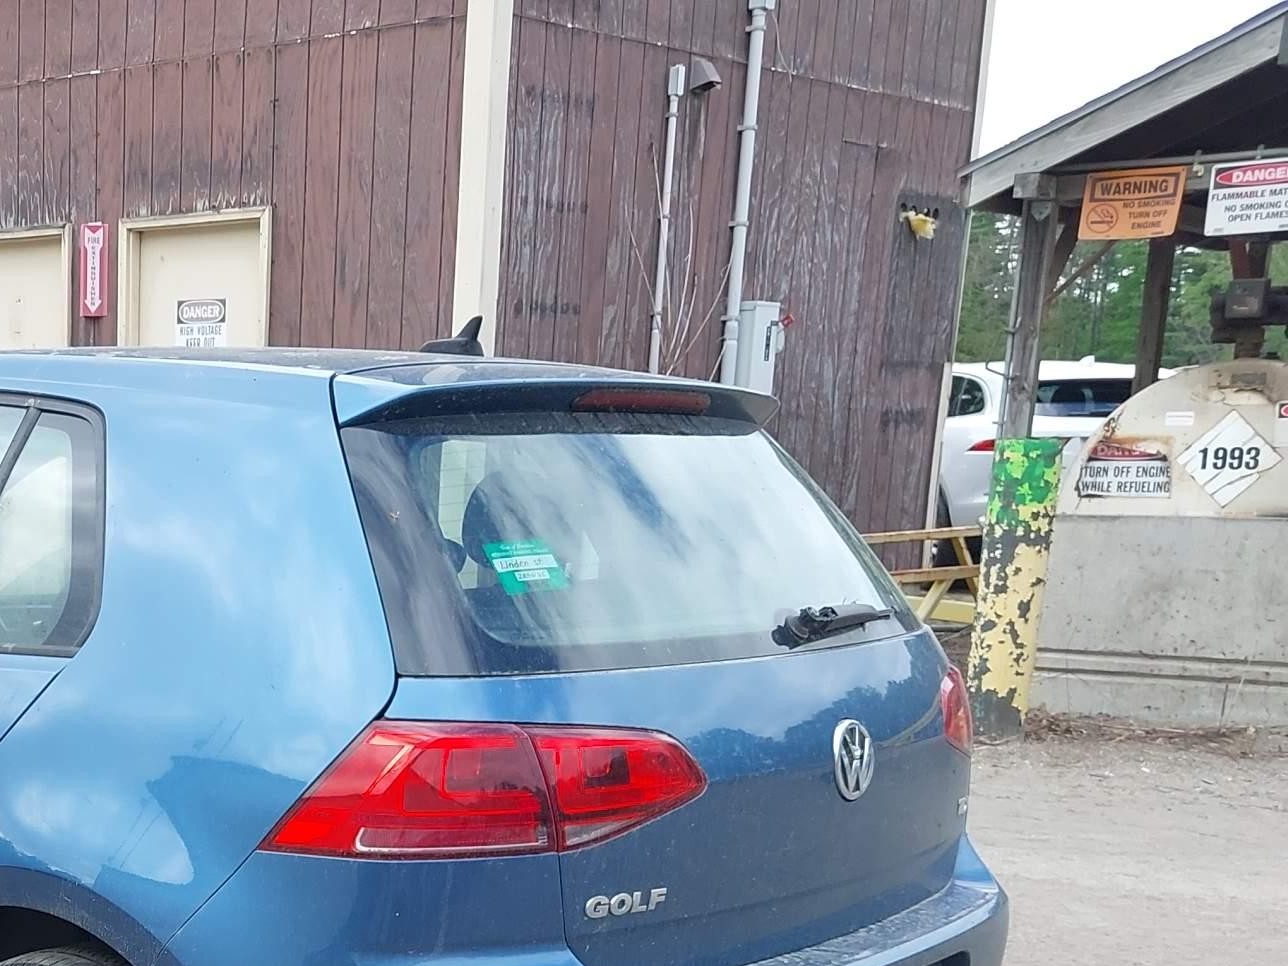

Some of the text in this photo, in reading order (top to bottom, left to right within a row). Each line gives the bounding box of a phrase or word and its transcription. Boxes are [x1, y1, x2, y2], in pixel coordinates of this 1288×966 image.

[1100, 180, 1169, 196] WARNING
[1211, 189, 1266, 201] FLAMMABLE
[1123, 199, 1176, 209] NO SMOKING
[1224, 204, 1237, 213] NO
[1239, 200, 1282, 212] SMOKING
[1128, 209, 1169, 220] TURN OFF
[1227, 213, 1252, 222] OPEN
[1131, 220, 1162, 230] ENGINE
[87, 236, 101, 245] FIRE
[182, 304, 221, 319] DANGER
[180, 325, 223, 336] HIGH VOLTAGE
[203, 336, 216, 348] OUT
[1198, 446, 1262, 470] 1993
[1083, 465, 1171, 479] TURN OFF ENGINE
[1081, 481, 1170, 493] WHILE REFUELING
[584, 887, 668, 919] GOLF
